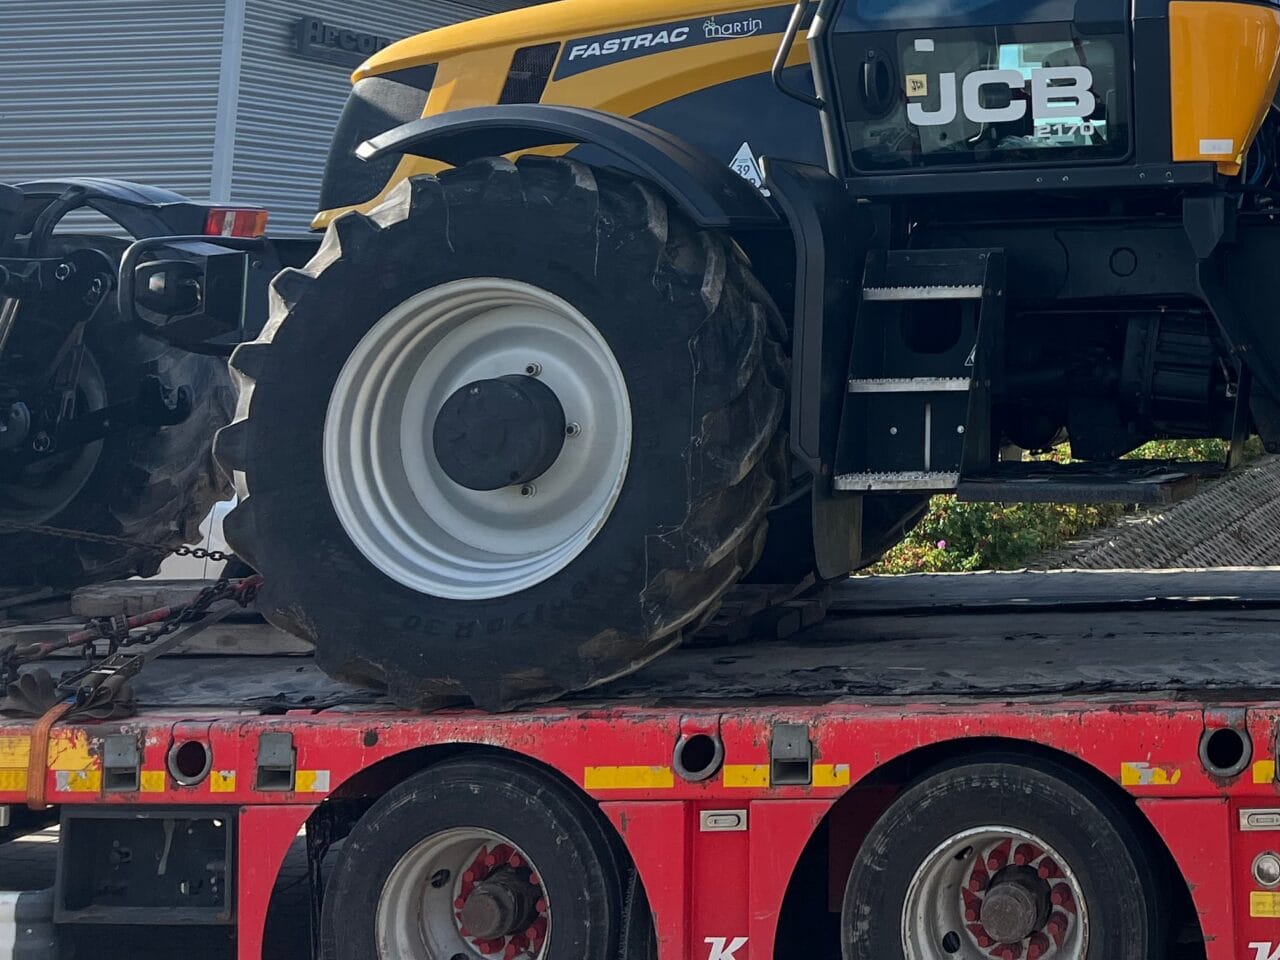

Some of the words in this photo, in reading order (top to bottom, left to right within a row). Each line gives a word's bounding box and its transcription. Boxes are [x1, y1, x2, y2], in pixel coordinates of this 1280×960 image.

[568, 26, 690, 61] FASTRAC
[907, 66, 1096, 126] JCB
[1038, 122, 1095, 138] 2170
